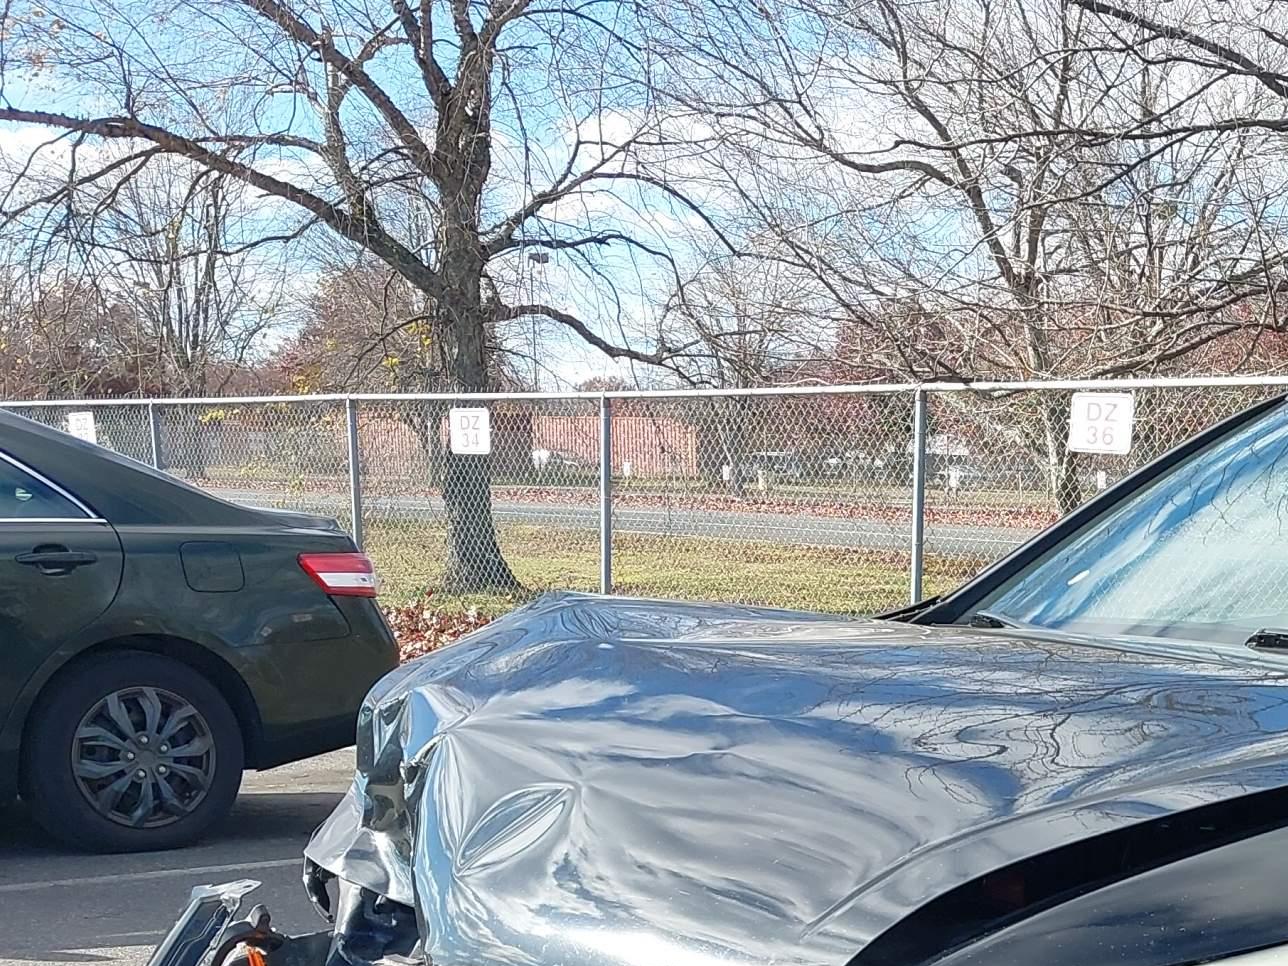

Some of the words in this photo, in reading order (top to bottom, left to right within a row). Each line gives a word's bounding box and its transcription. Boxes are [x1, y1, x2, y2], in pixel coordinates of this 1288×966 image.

[1087, 402, 1118, 422] DZ
[460, 415, 480, 430] DZ
[462, 432, 479, 448] 34
[1087, 425, 1114, 446] 36
